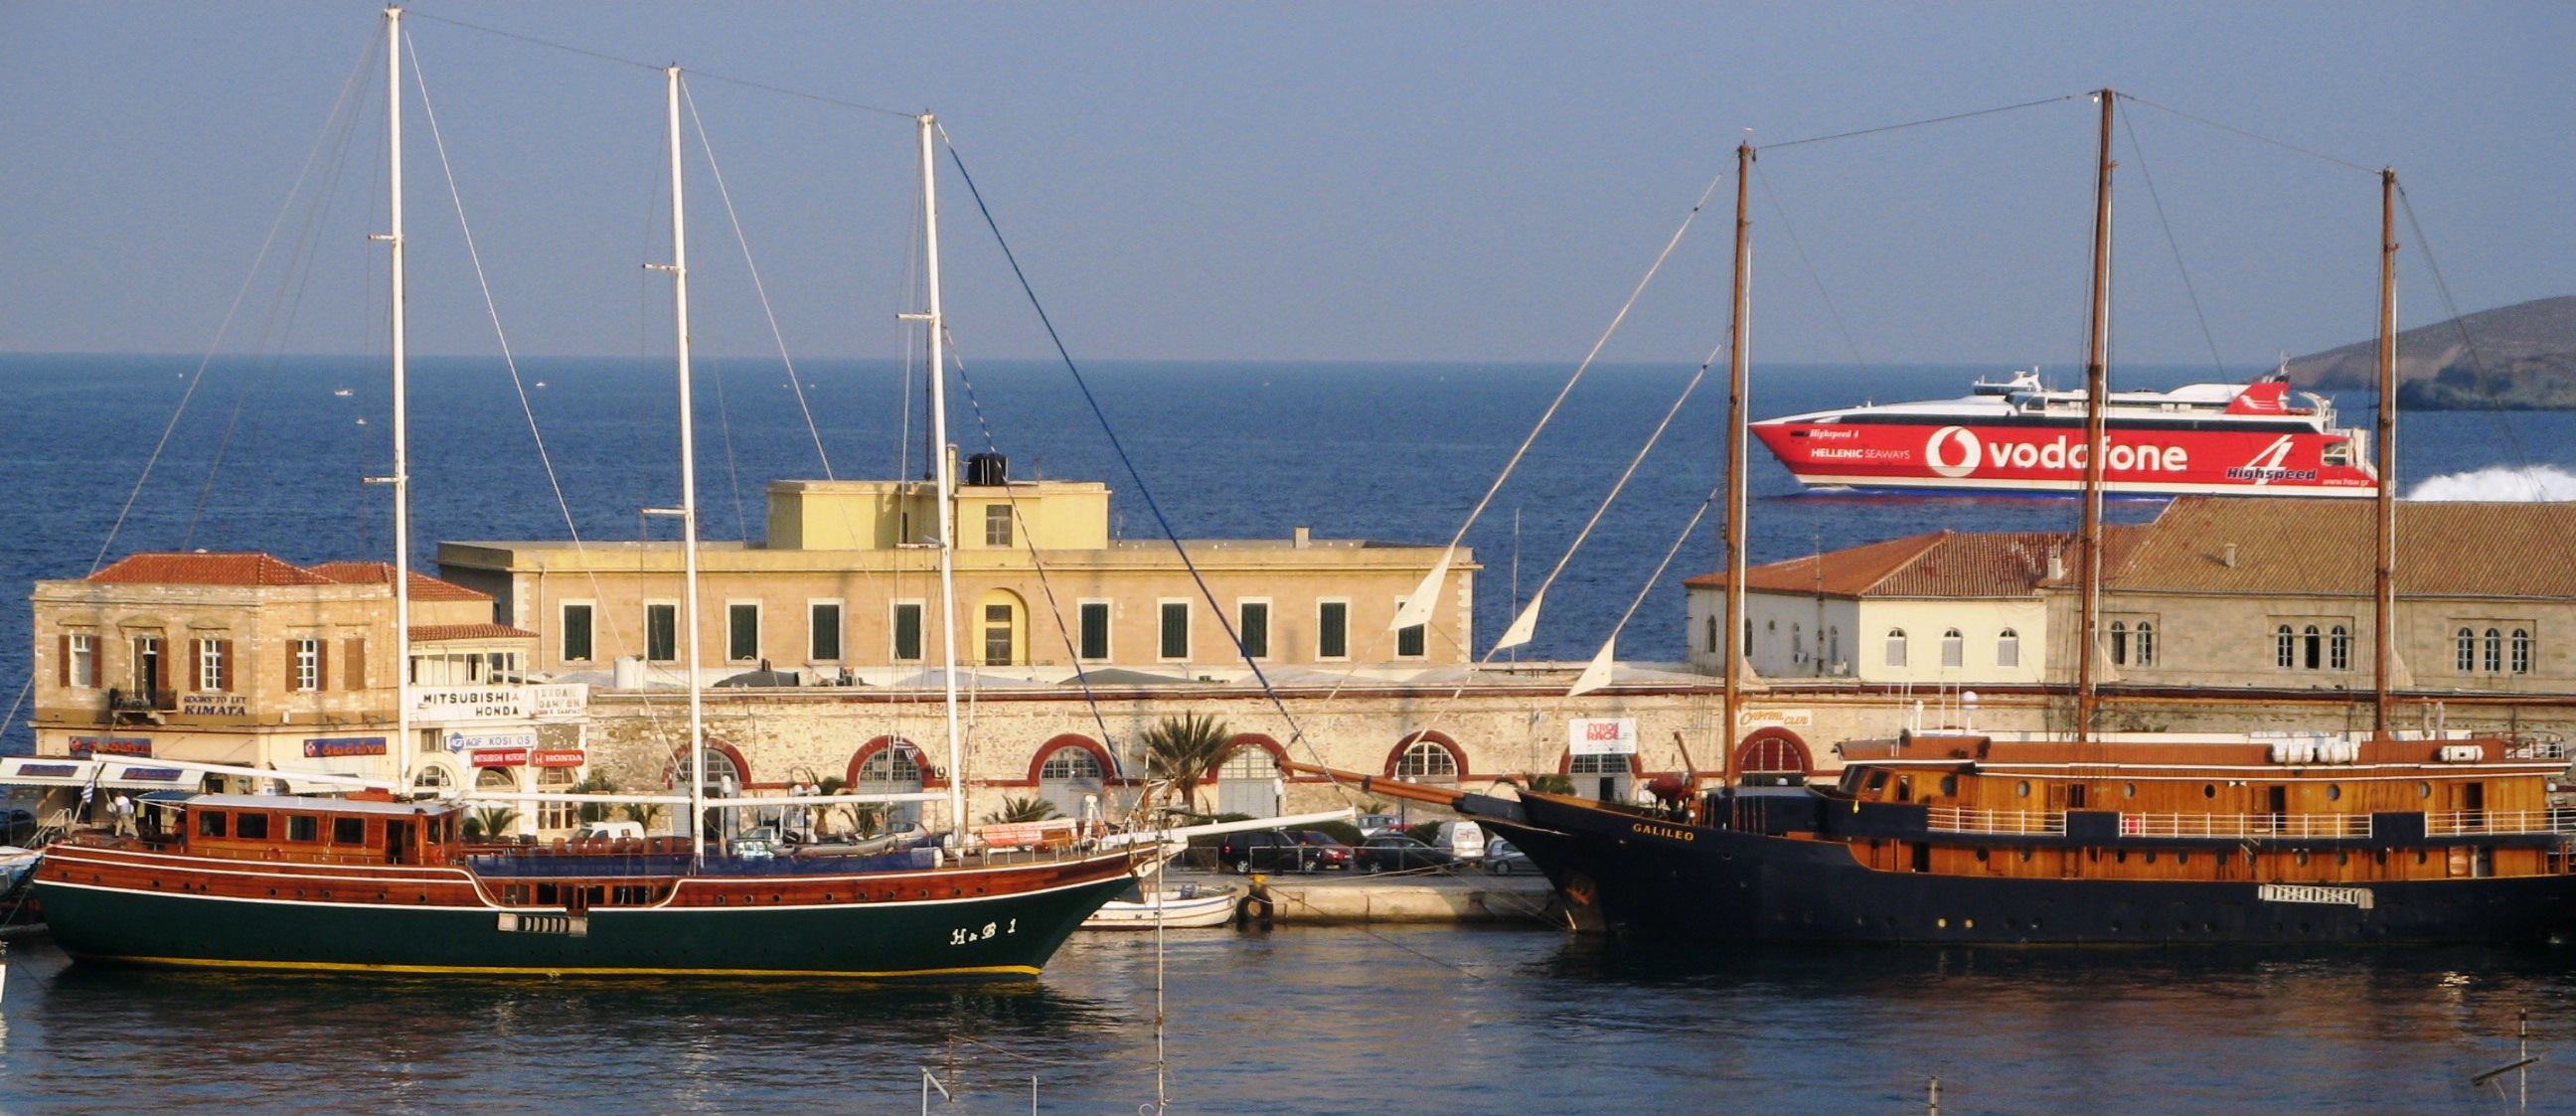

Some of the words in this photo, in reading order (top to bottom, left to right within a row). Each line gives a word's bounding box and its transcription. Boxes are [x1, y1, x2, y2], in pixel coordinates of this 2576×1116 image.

[1810, 429, 1852, 439] Highspeed
[1852, 429, 1859, 438] 4
[1811, 448, 1863, 458] HELLENIC
[1864, 449, 1910, 459] SEAWAYS
[1989, 434, 2188, 472] vodafone
[2226, 466, 2318, 482] Highspeed
[423, 692, 510, 705] MITSUBISHI
[184, 705, 246, 717] KIMATA
[475, 706, 519, 717] HONDA
[1784, 716, 1809, 725] CLUB
[465, 737, 482, 746] AGF
[546, 753, 583, 763] HONDA
[1633, 823, 1694, 842] GALILEO
